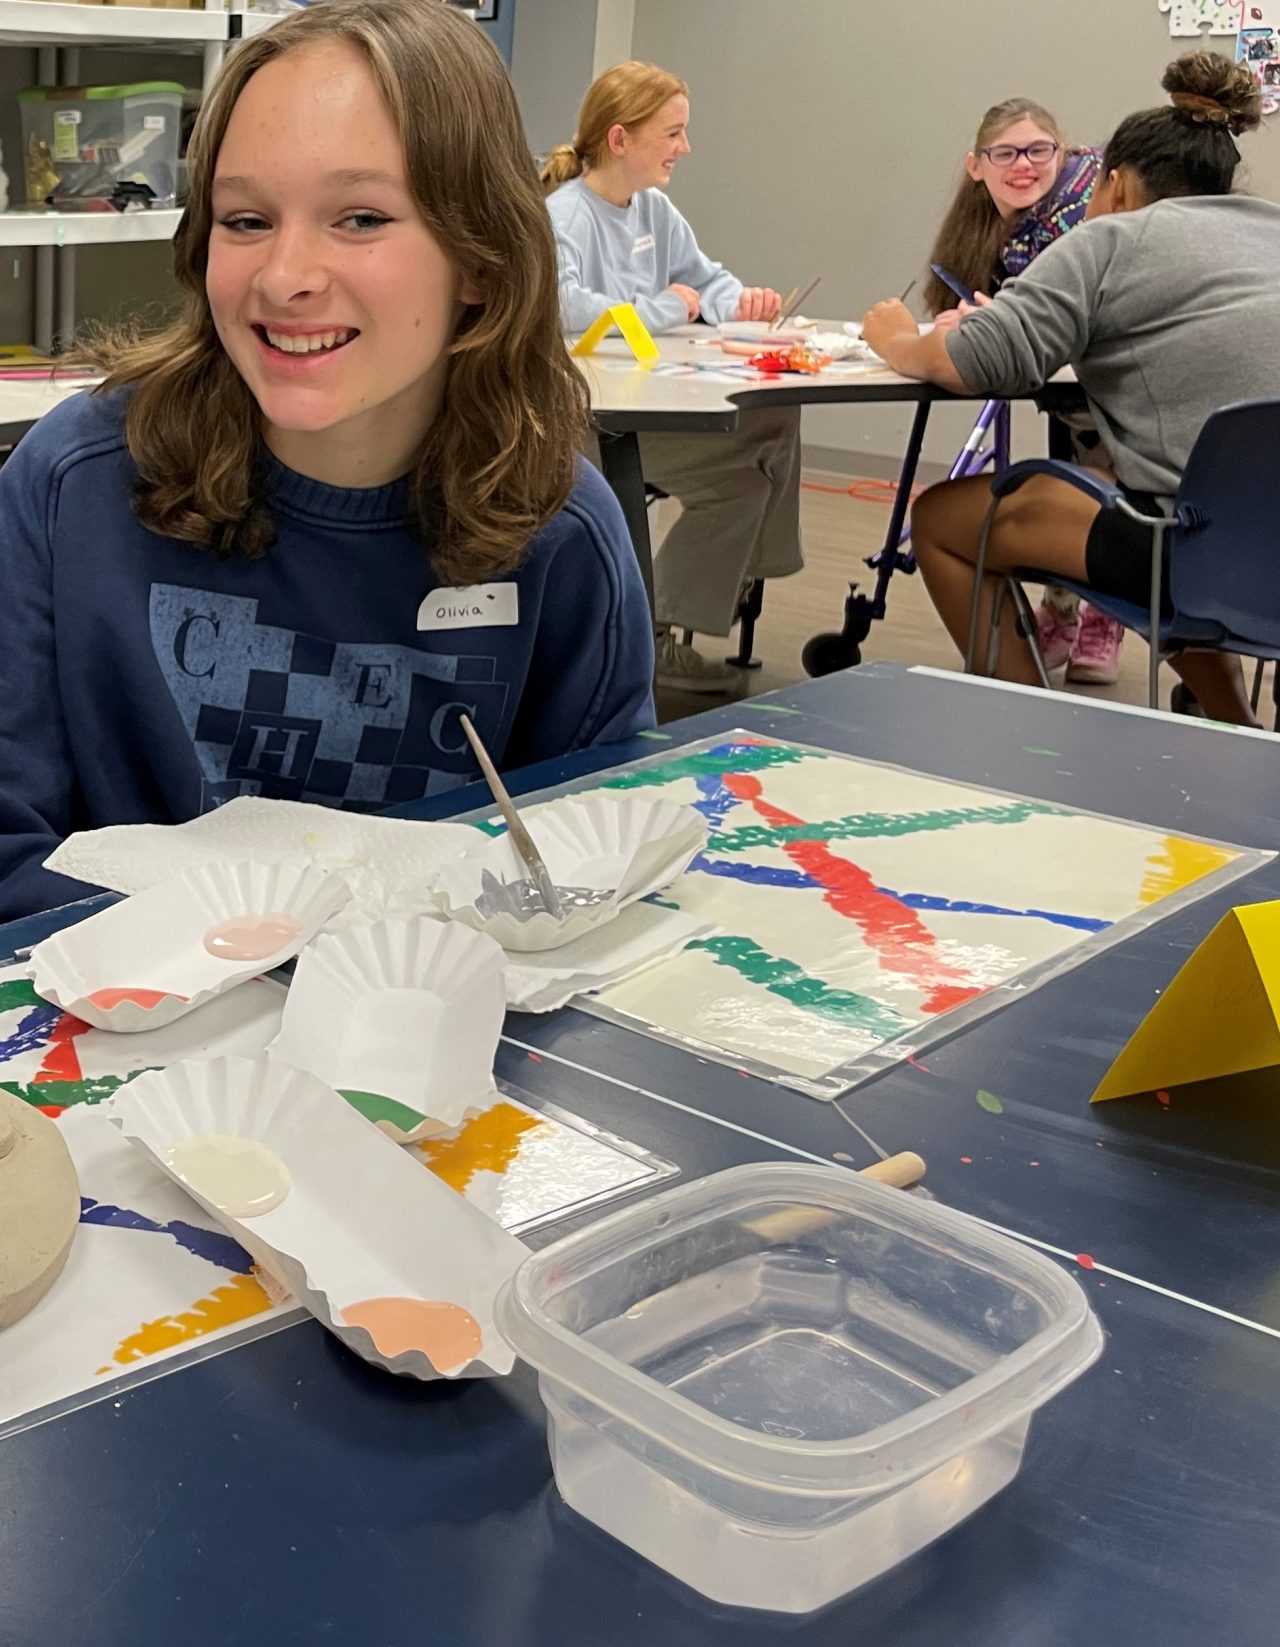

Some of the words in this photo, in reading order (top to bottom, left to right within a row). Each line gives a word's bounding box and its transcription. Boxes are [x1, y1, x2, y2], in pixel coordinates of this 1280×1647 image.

[435, 606, 483, 619] Olivia
[173, 615, 220, 680] C
[238, 725, 310, 780] H
[352, 664, 392, 709] E
